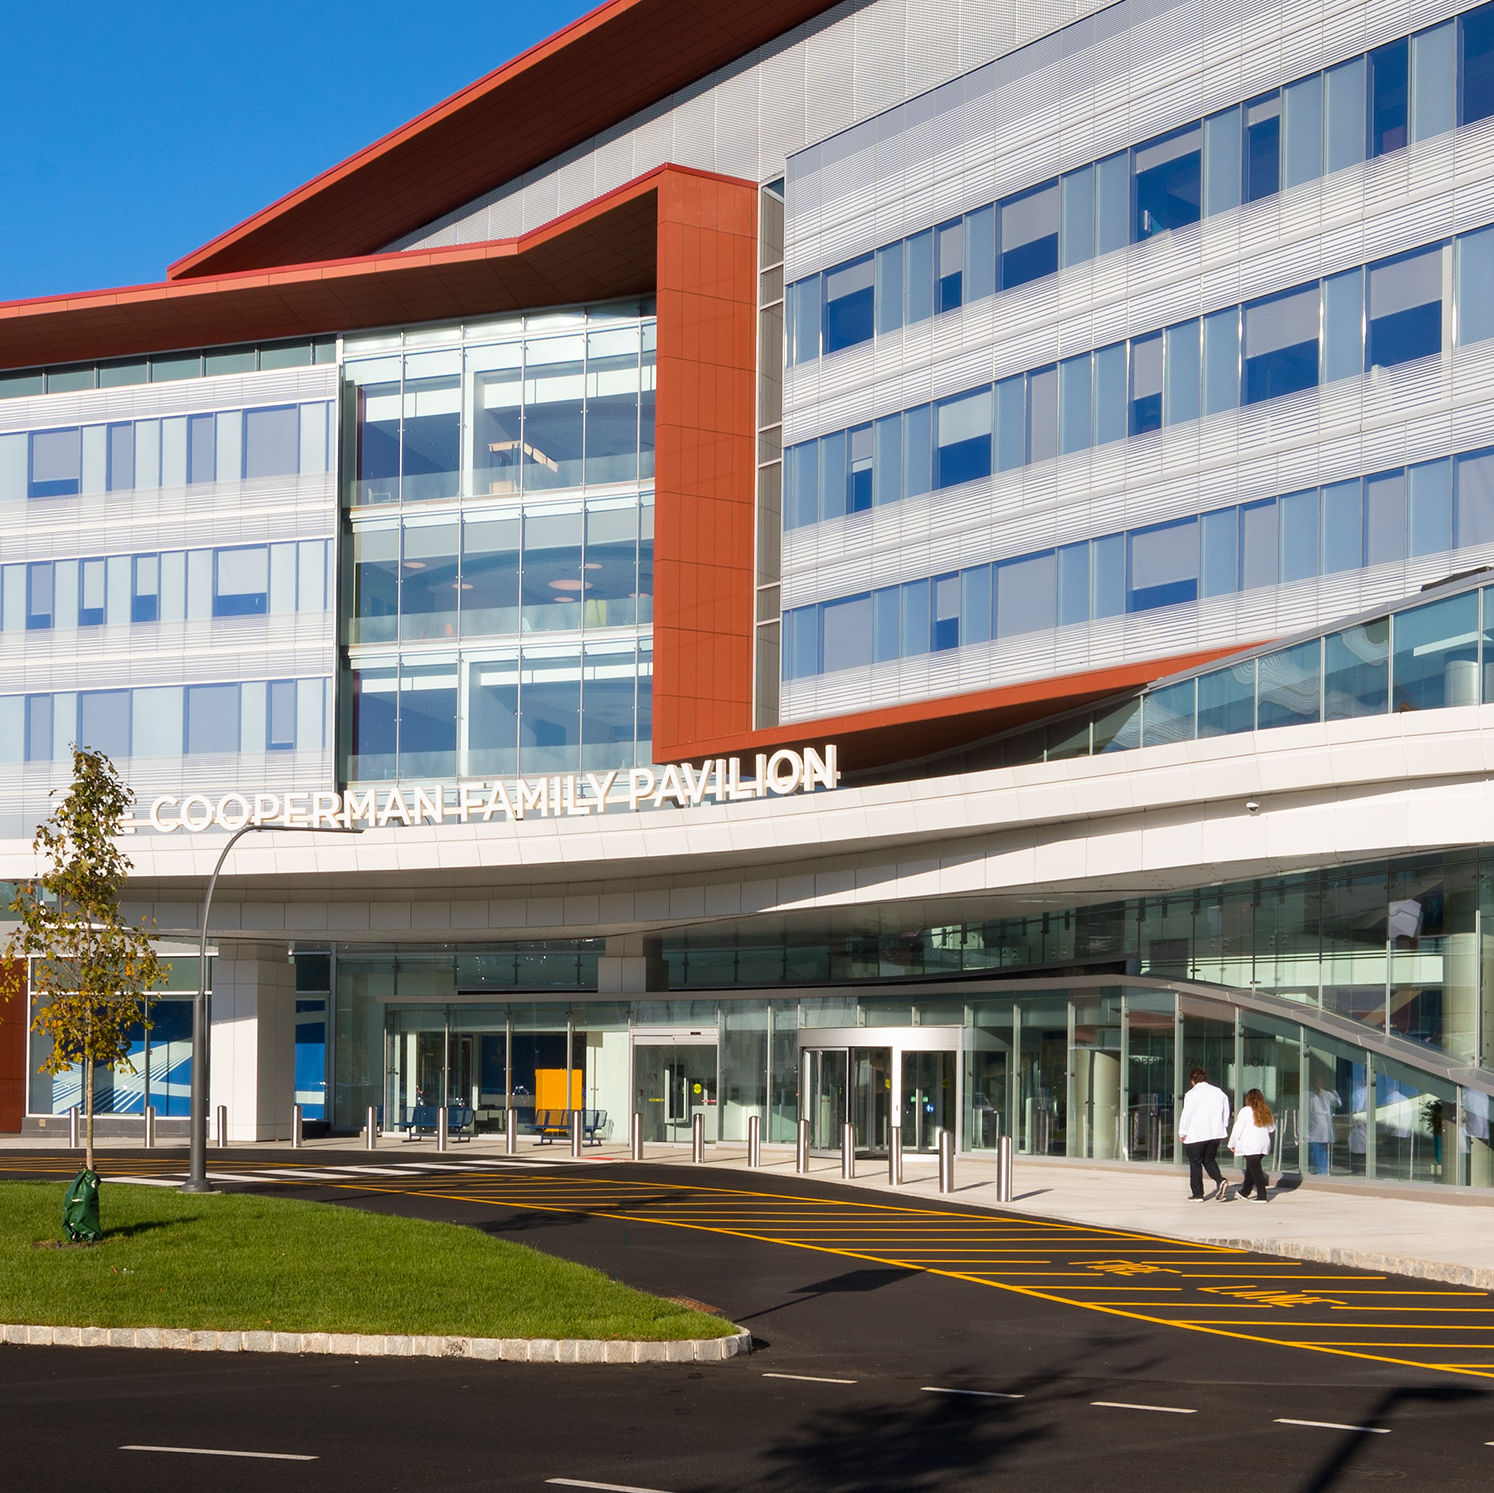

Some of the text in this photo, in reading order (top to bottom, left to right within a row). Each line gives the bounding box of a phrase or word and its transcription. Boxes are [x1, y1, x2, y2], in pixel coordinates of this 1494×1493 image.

[150, 785, 444, 833] COOPERMAN
[460, 771, 619, 823] FAMILY
[629, 744, 838, 810] PAVILION
[1068, 1259, 1348, 1307] FIRE LANE
